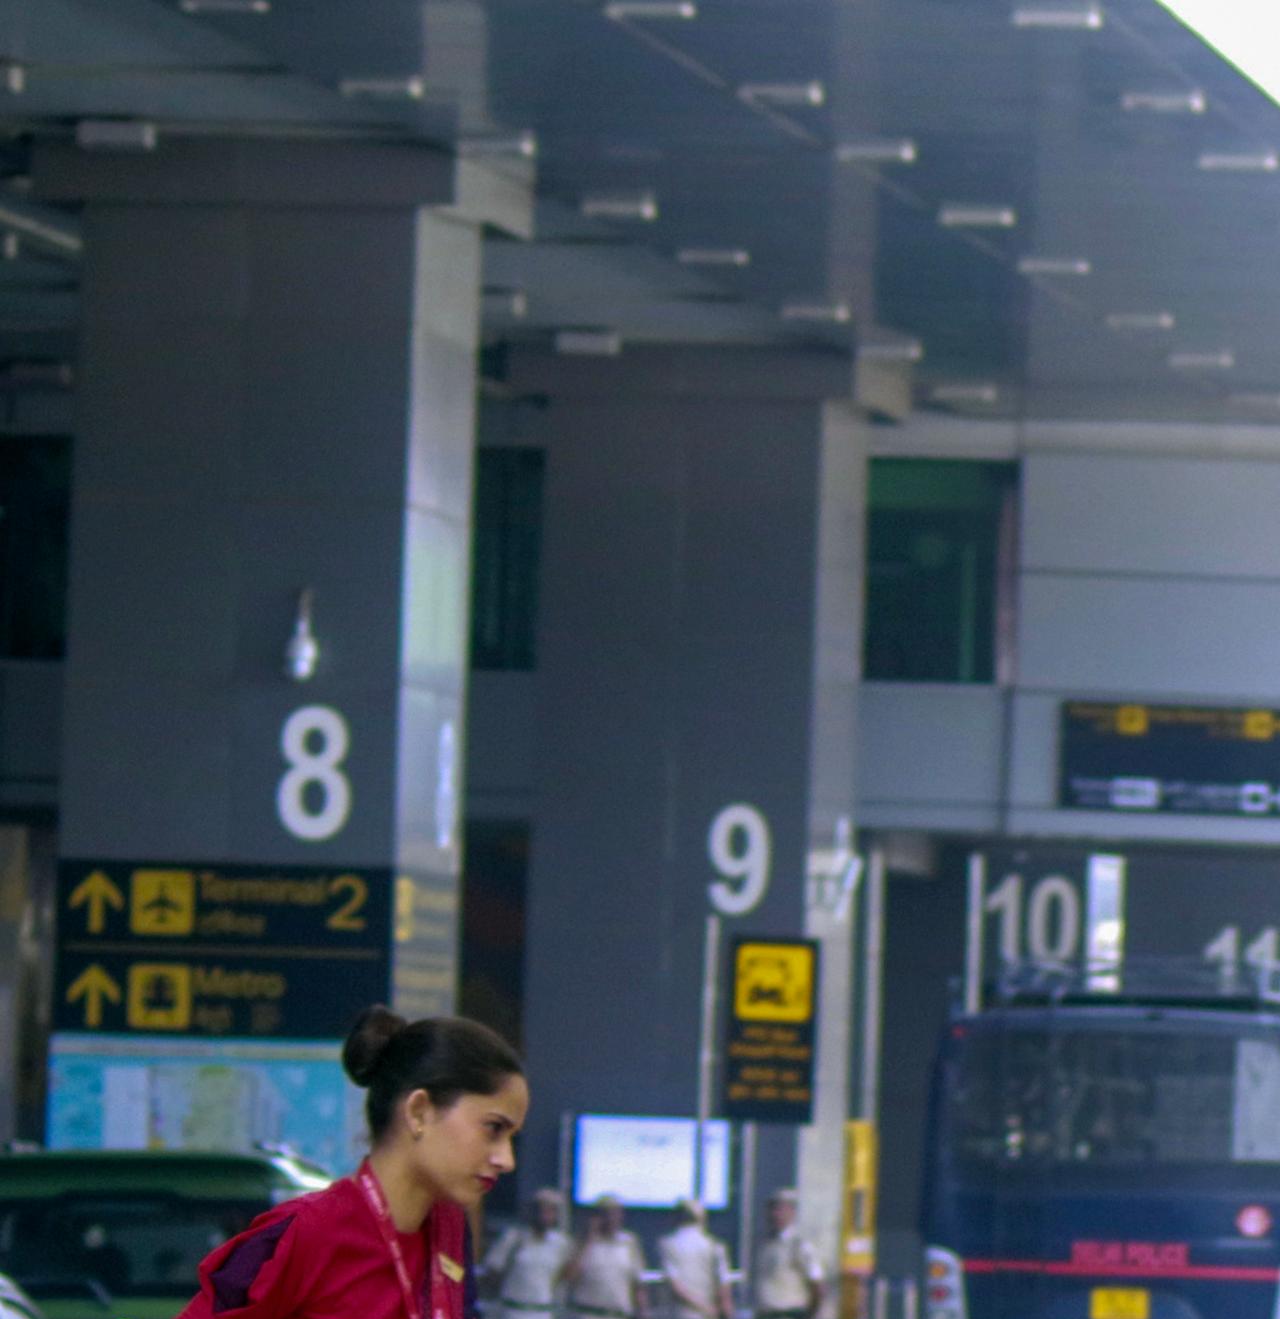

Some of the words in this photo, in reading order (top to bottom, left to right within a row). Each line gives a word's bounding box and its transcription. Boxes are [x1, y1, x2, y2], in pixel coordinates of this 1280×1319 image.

[277, 705, 351, 840] 8
[326, 874, 368, 930] 2
[707, 803, 769, 914] 9
[986, 874, 1079, 966] 10
